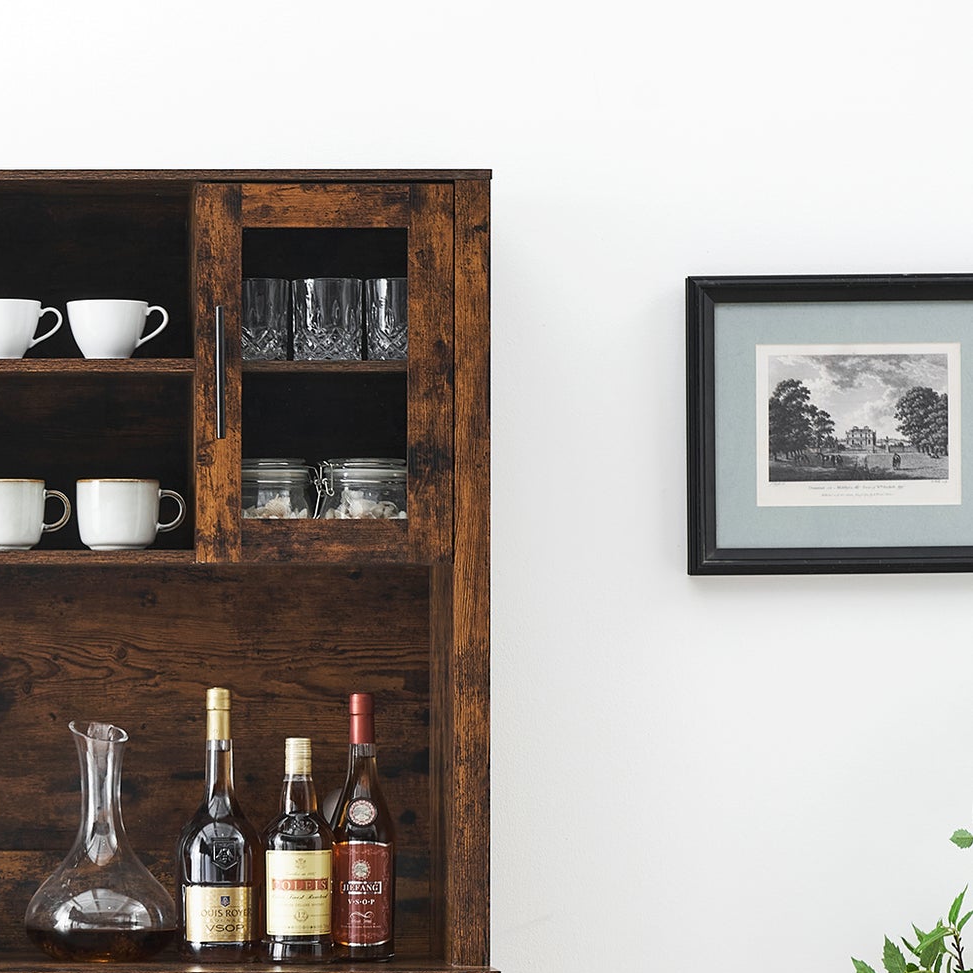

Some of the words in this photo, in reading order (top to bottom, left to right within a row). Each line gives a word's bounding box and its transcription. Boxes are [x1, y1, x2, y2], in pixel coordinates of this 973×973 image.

[275, 880, 327, 890] OLEIS
[200, 909, 223, 917] OUIS
[206, 924, 244, 932] VSOP
